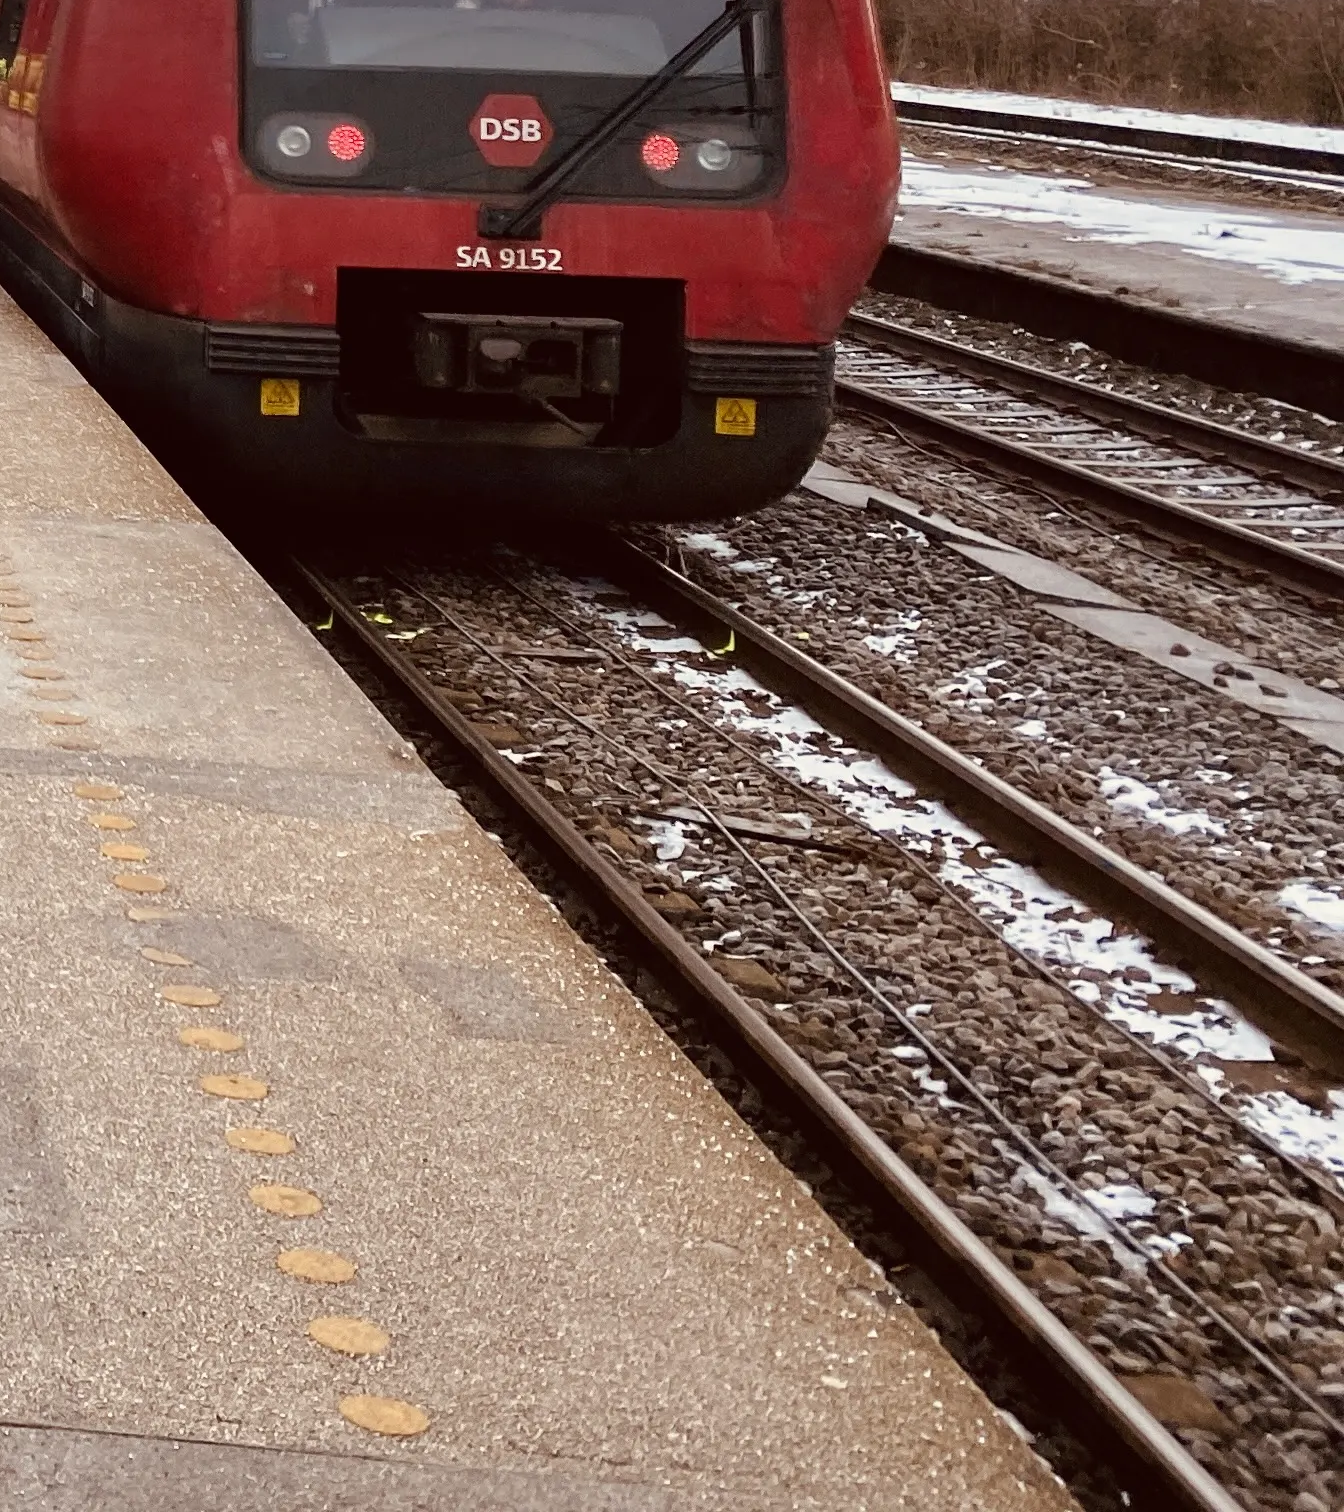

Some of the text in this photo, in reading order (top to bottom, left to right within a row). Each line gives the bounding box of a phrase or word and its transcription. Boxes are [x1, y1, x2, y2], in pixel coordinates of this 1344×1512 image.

[479, 117, 543, 143] DSB
[456, 245, 564, 272] SA 9152
